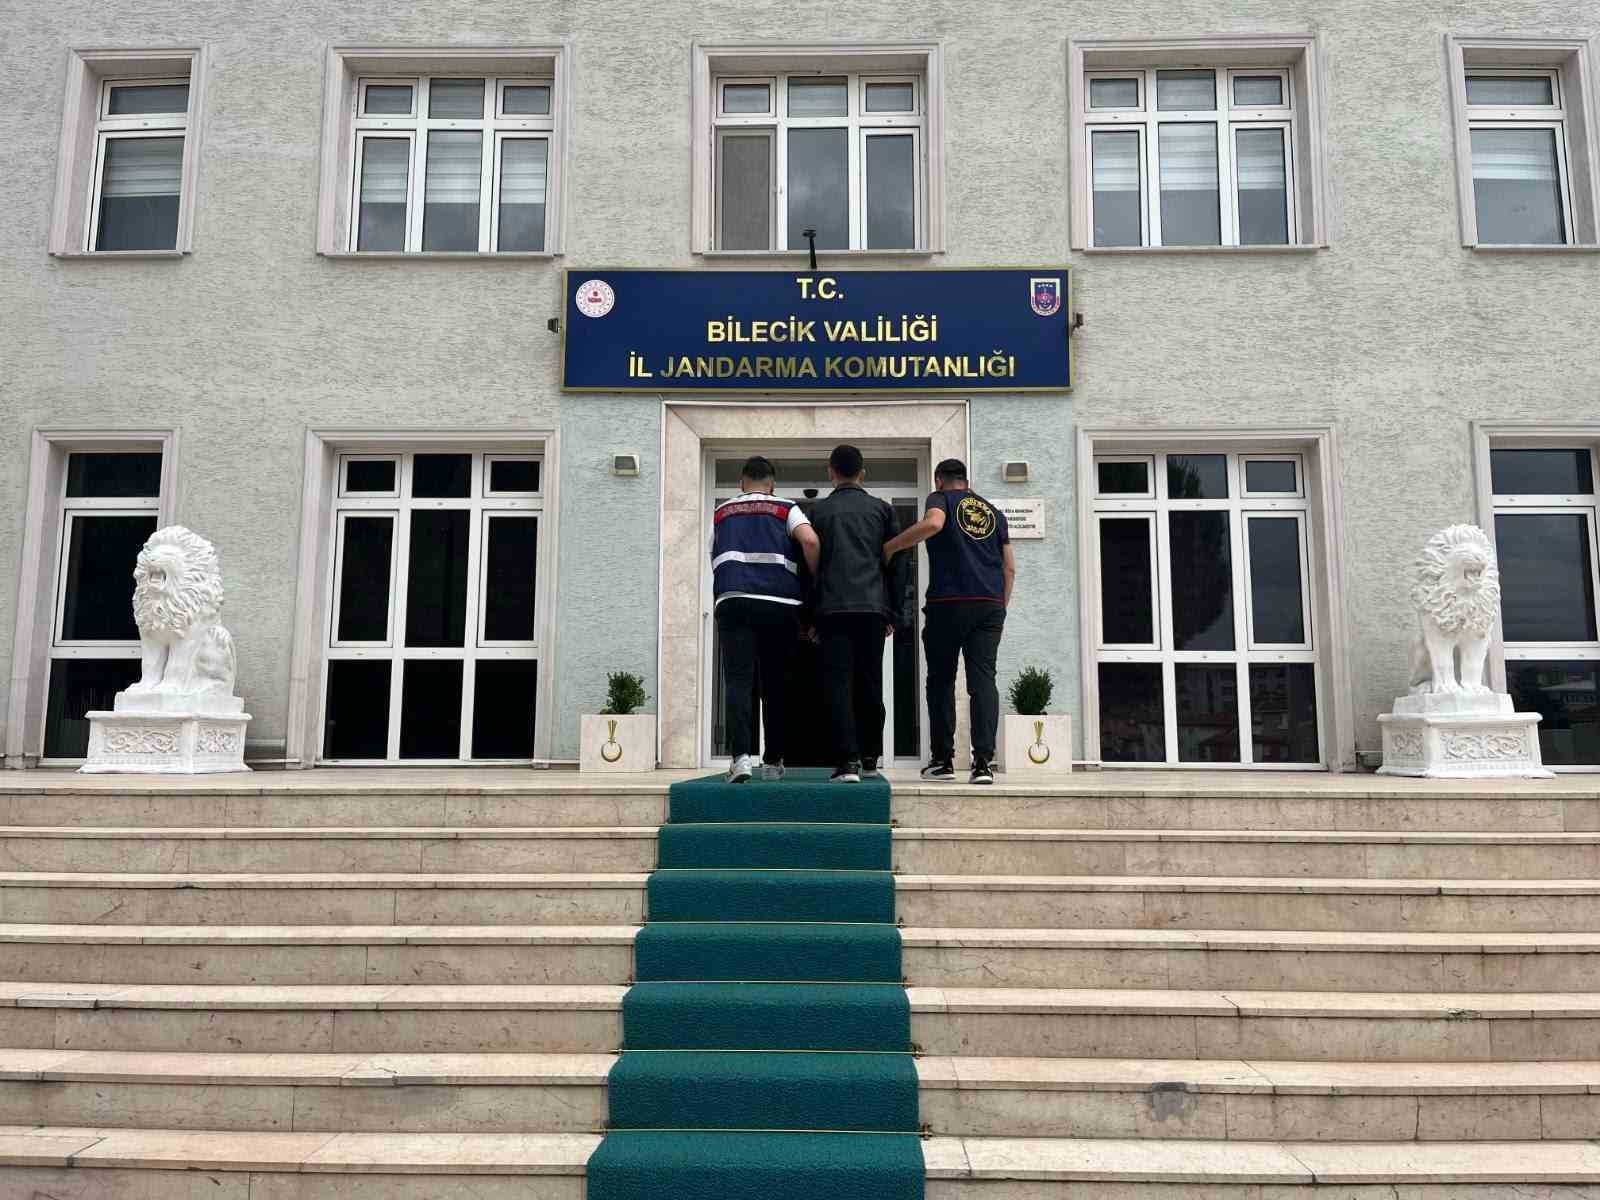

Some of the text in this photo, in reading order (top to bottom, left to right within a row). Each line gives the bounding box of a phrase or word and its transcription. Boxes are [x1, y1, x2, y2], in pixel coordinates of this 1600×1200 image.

[797, 278, 845, 299] T.C.
[707, 313, 938, 342] BİLECİK VALİLİĞİ
[629, 349, 1016, 378] İL JANDARMA KOMUTANLIĞI
